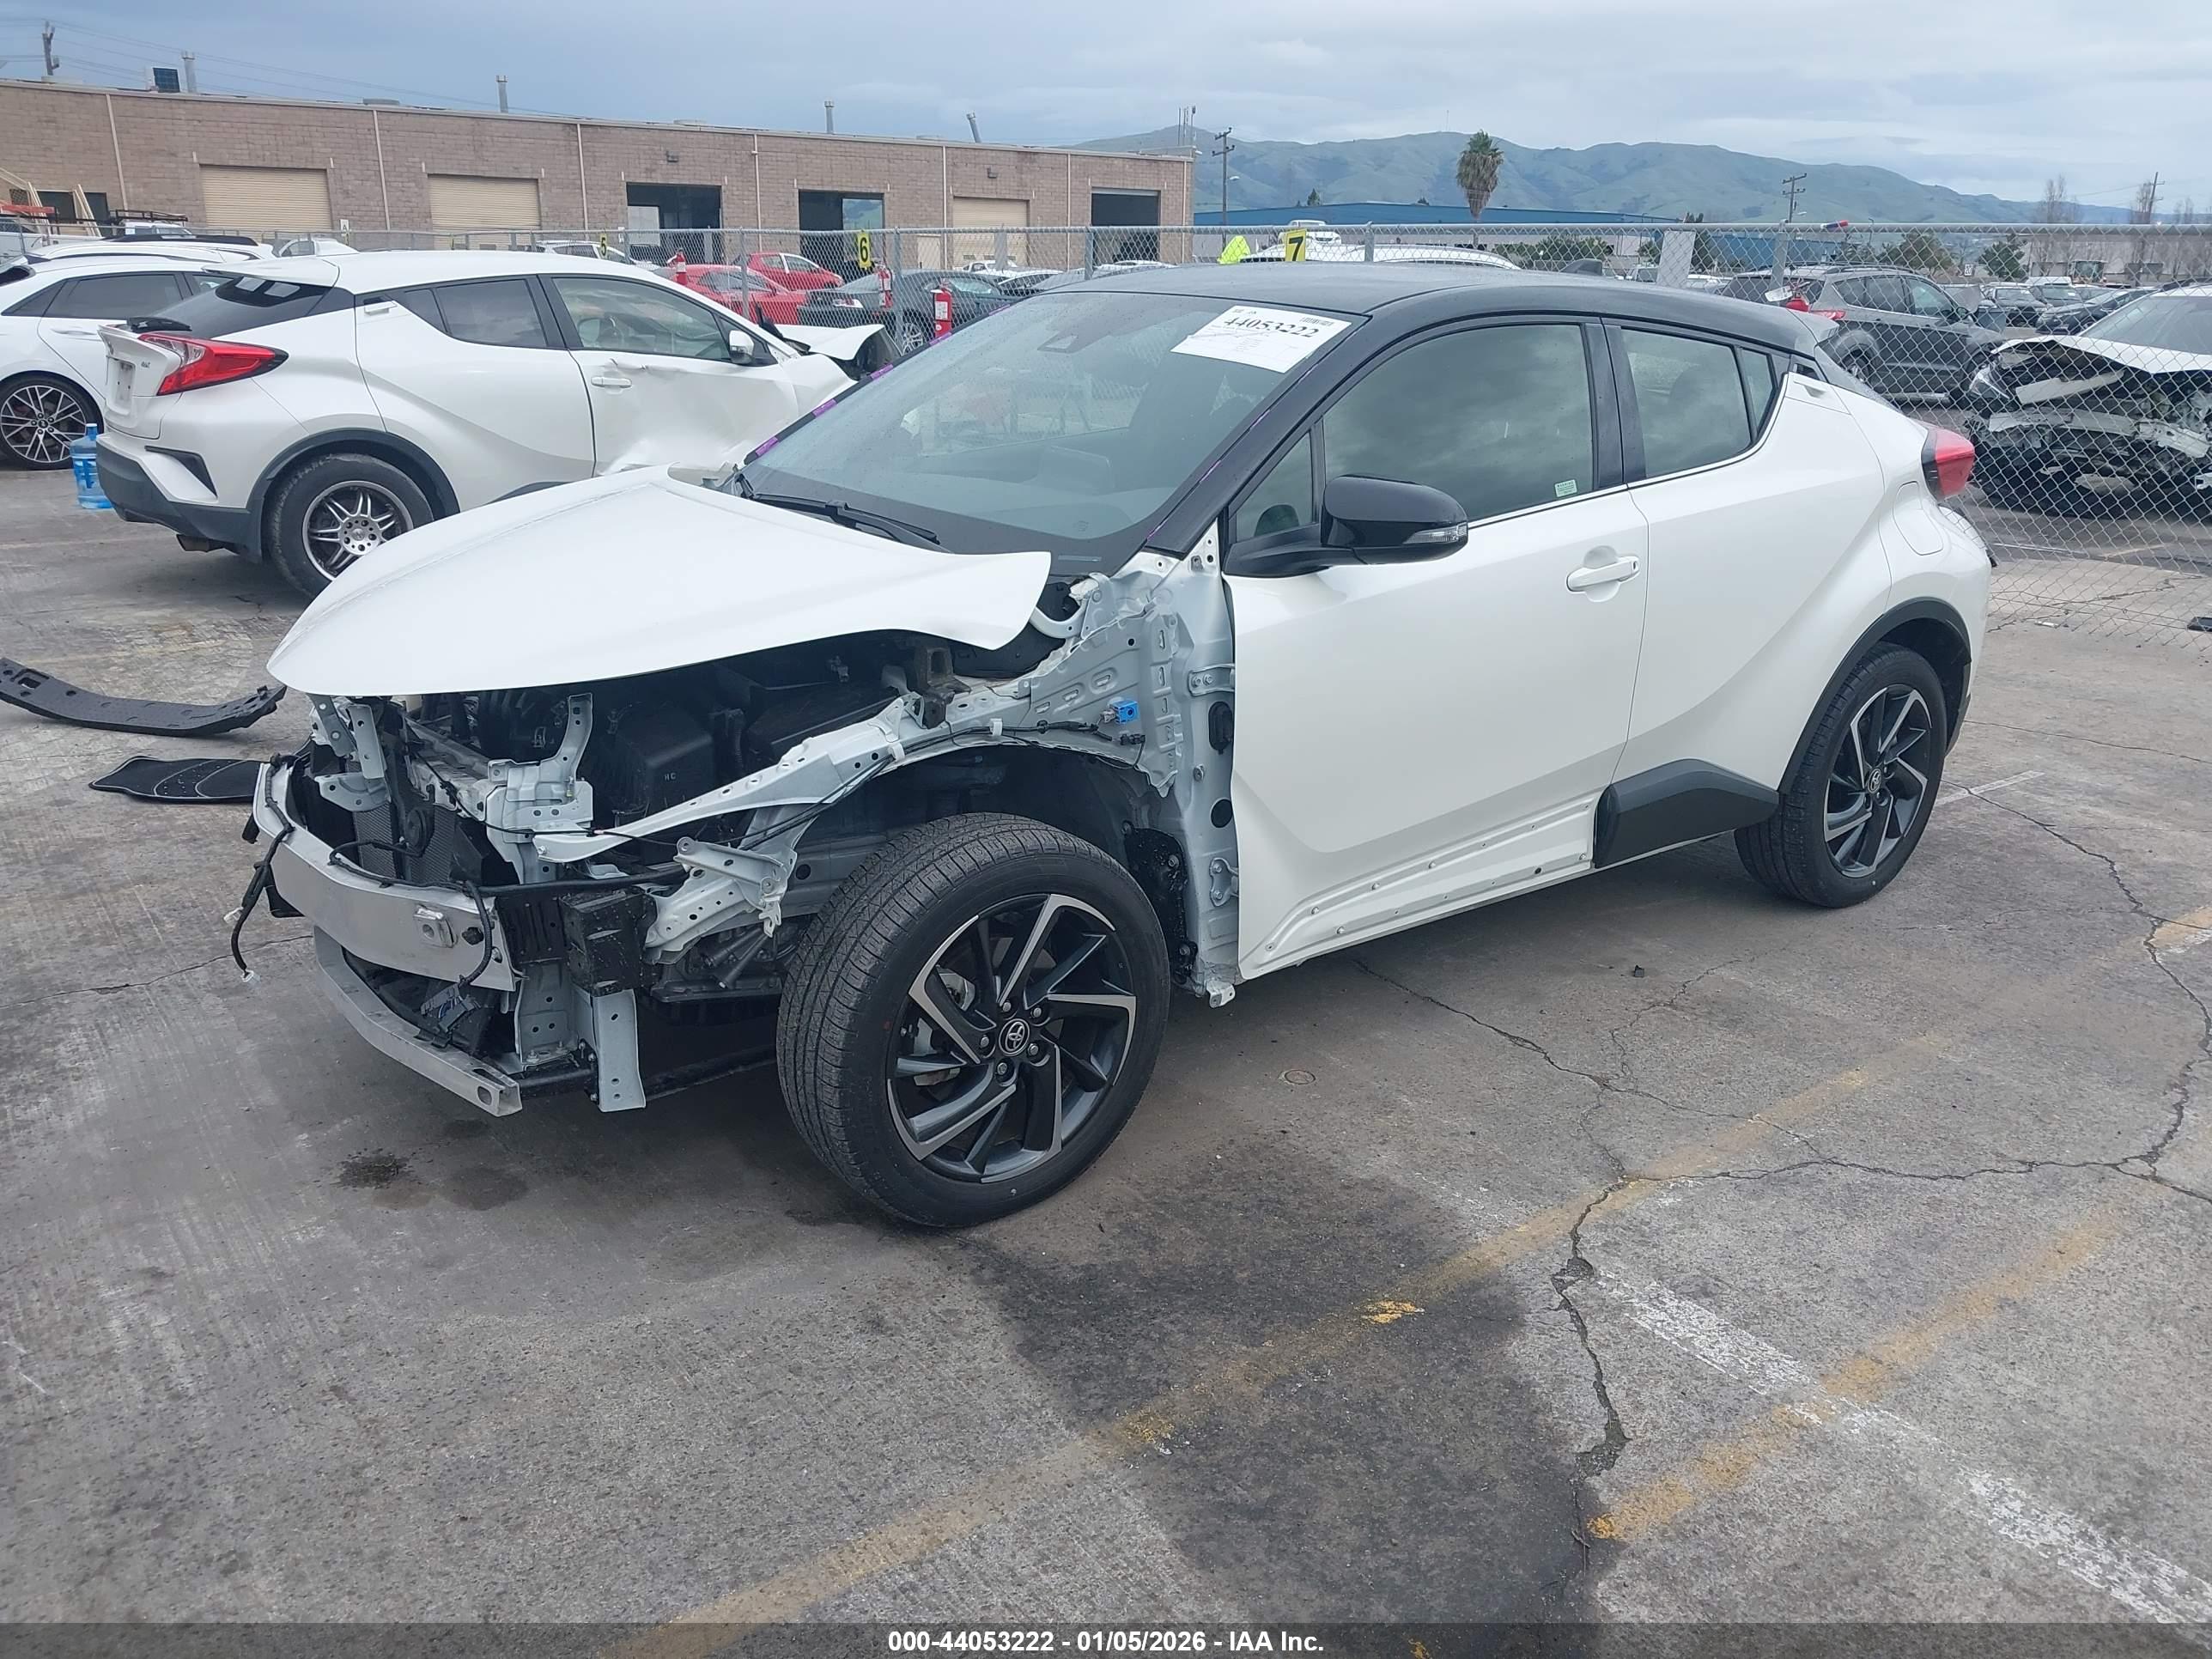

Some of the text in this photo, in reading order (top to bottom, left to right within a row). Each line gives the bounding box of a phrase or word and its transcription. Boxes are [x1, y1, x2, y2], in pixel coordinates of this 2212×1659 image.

[601, 236, 607, 257] 5
[860, 236, 868, 263] 6
[1289, 236, 1304, 261] 7
[1224, 317, 1319, 337] 44053222
